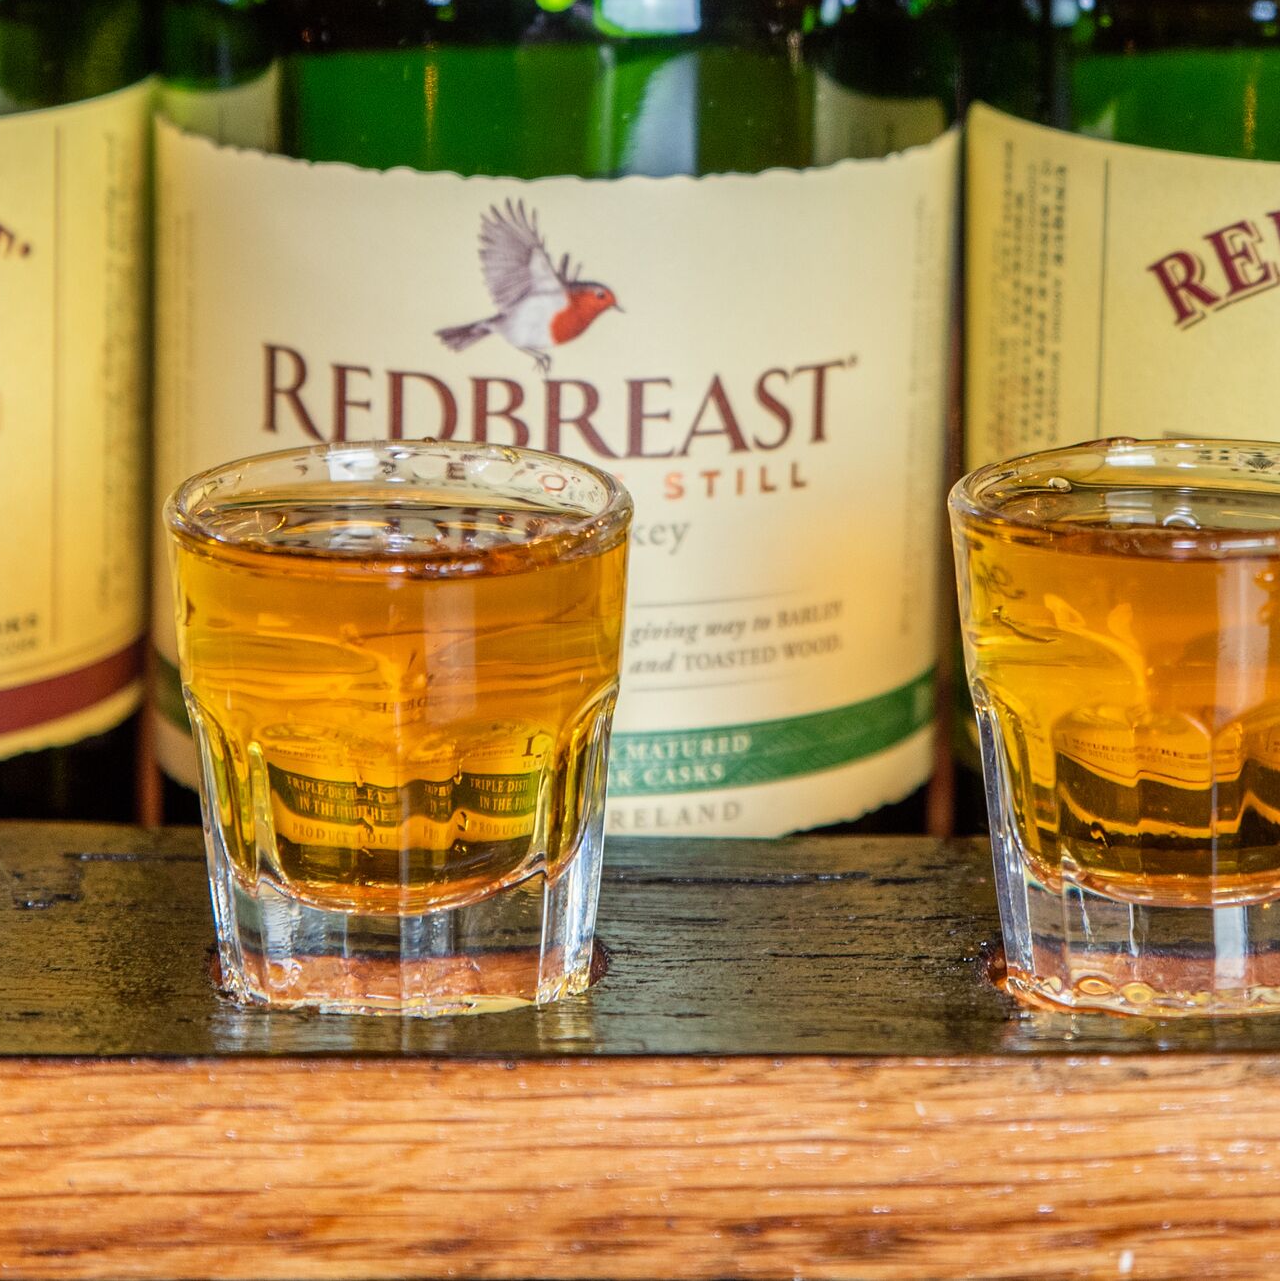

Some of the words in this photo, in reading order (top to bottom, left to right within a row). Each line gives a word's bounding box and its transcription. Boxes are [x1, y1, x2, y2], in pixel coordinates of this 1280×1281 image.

[263, 343, 847, 459] REDBREAST
[663, 463, 808, 501] STILL
[629, 651, 678, 673] and
[683, 646, 778, 671] TOASTED
[627, 732, 752, 761] MATURED
[643, 763, 726, 787] CASKS
[609, 800, 743, 830] RELAND
